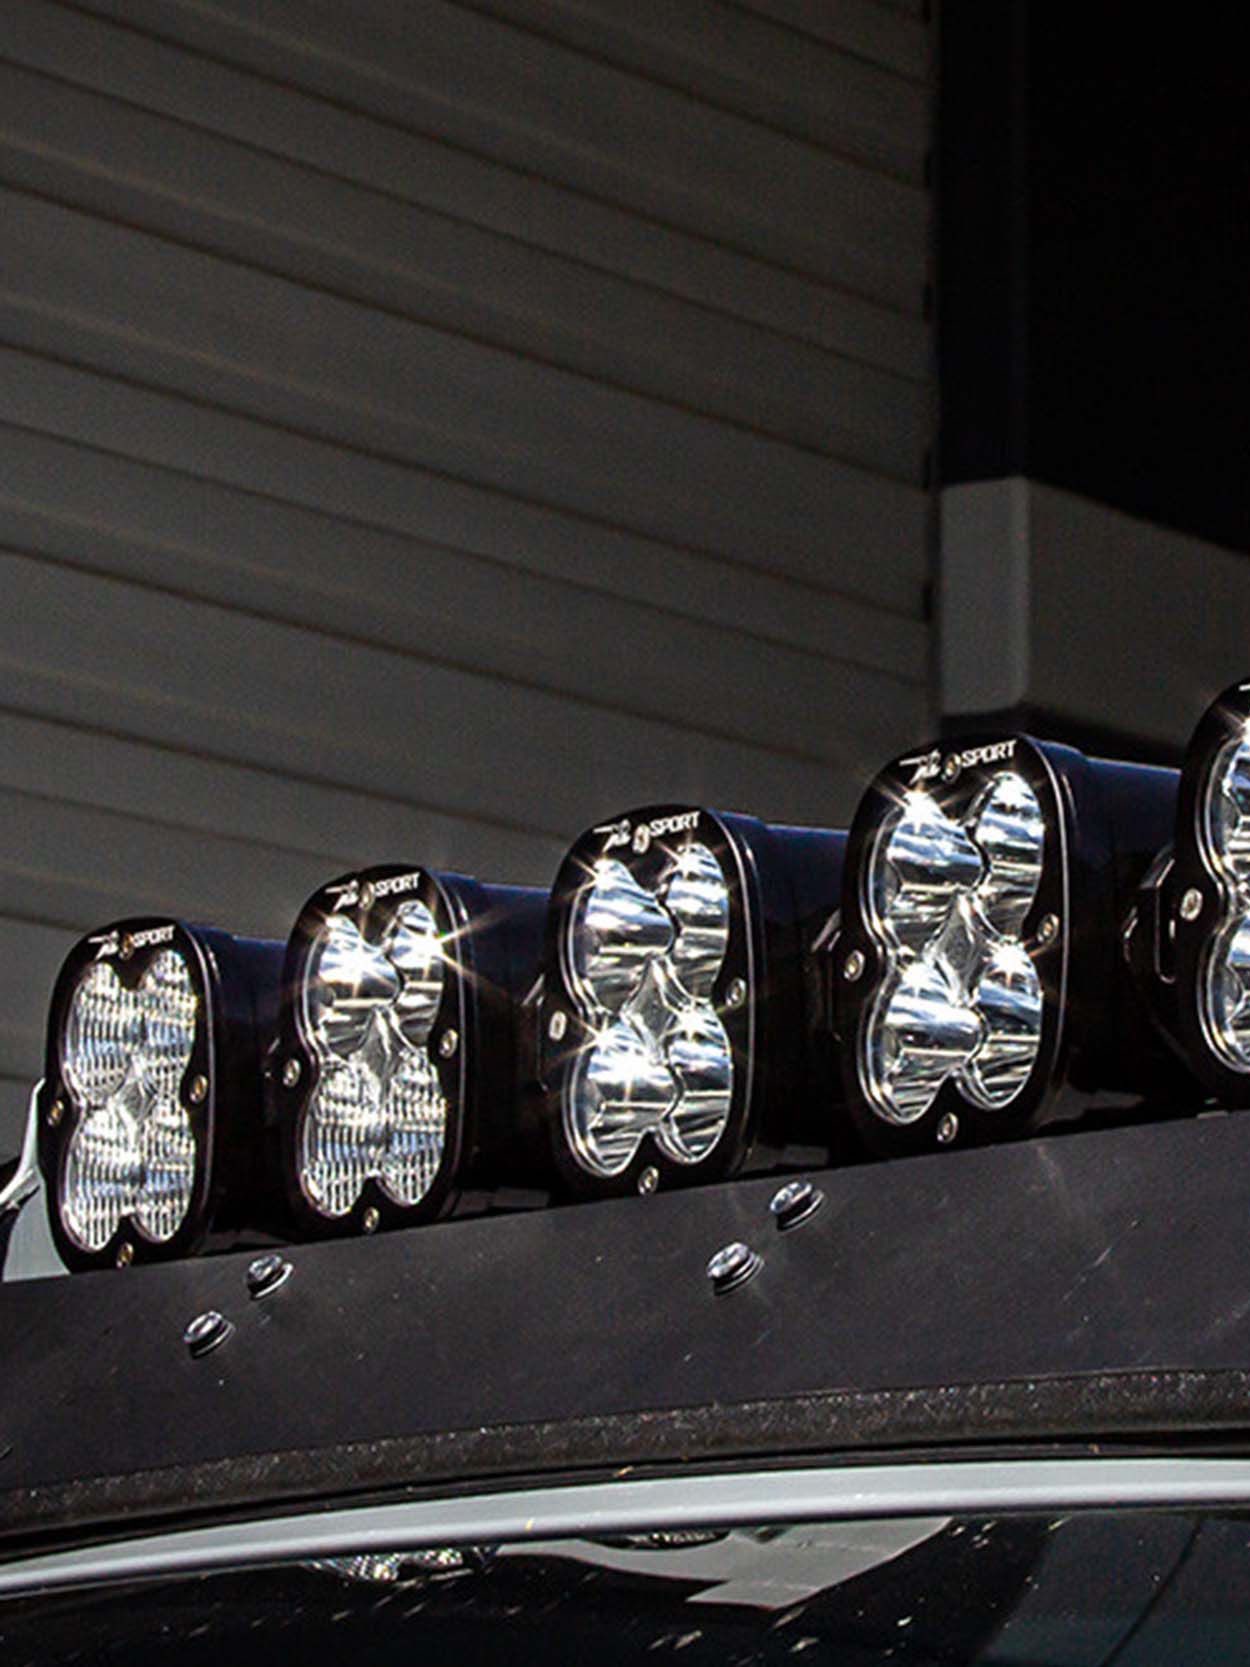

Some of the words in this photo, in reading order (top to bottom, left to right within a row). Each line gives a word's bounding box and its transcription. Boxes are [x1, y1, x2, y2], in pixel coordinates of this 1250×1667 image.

[962, 740, 1016, 768] SPORT
[649, 811, 700, 836] SPORT
[375, 872, 419, 897] SPORT
